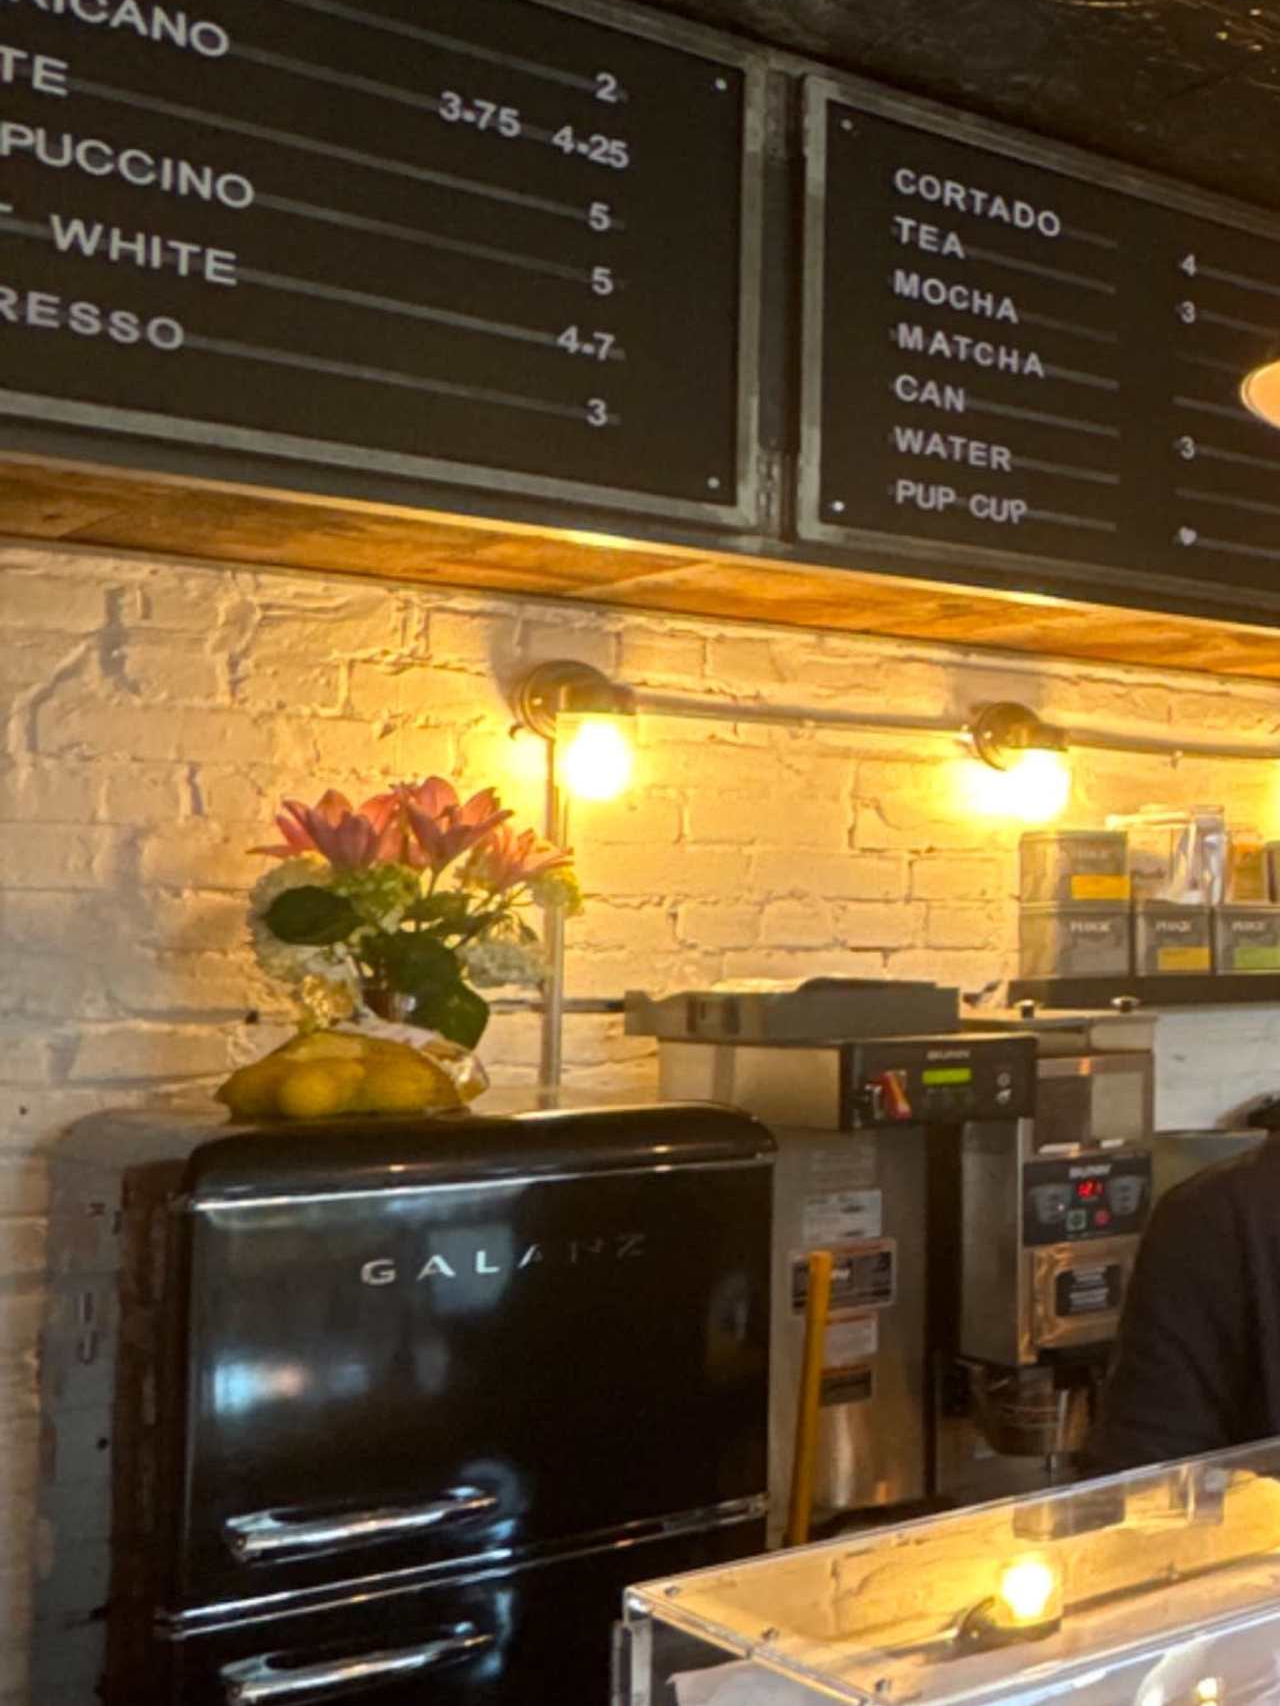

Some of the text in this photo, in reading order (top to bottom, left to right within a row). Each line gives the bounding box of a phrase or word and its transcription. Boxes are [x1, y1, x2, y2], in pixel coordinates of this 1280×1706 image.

[596, 72, 618, 102] 2
[588, 201, 612, 231] 5
[894, 168, 1197, 277] CORTADO 4
[50, 213, 238, 286] WHITE
[894, 215, 1196, 324] TEA 3
[591, 266, 615, 295] 5
[893, 268, 1019, 324] MOCHA
[896, 322, 1045, 378] MATCHA
[586, 397, 608, 427] 3
[894, 373, 1196, 460] CAN 3
[894, 425, 1012, 471] WATER
[895, 478, 1028, 525] PUP CUP
